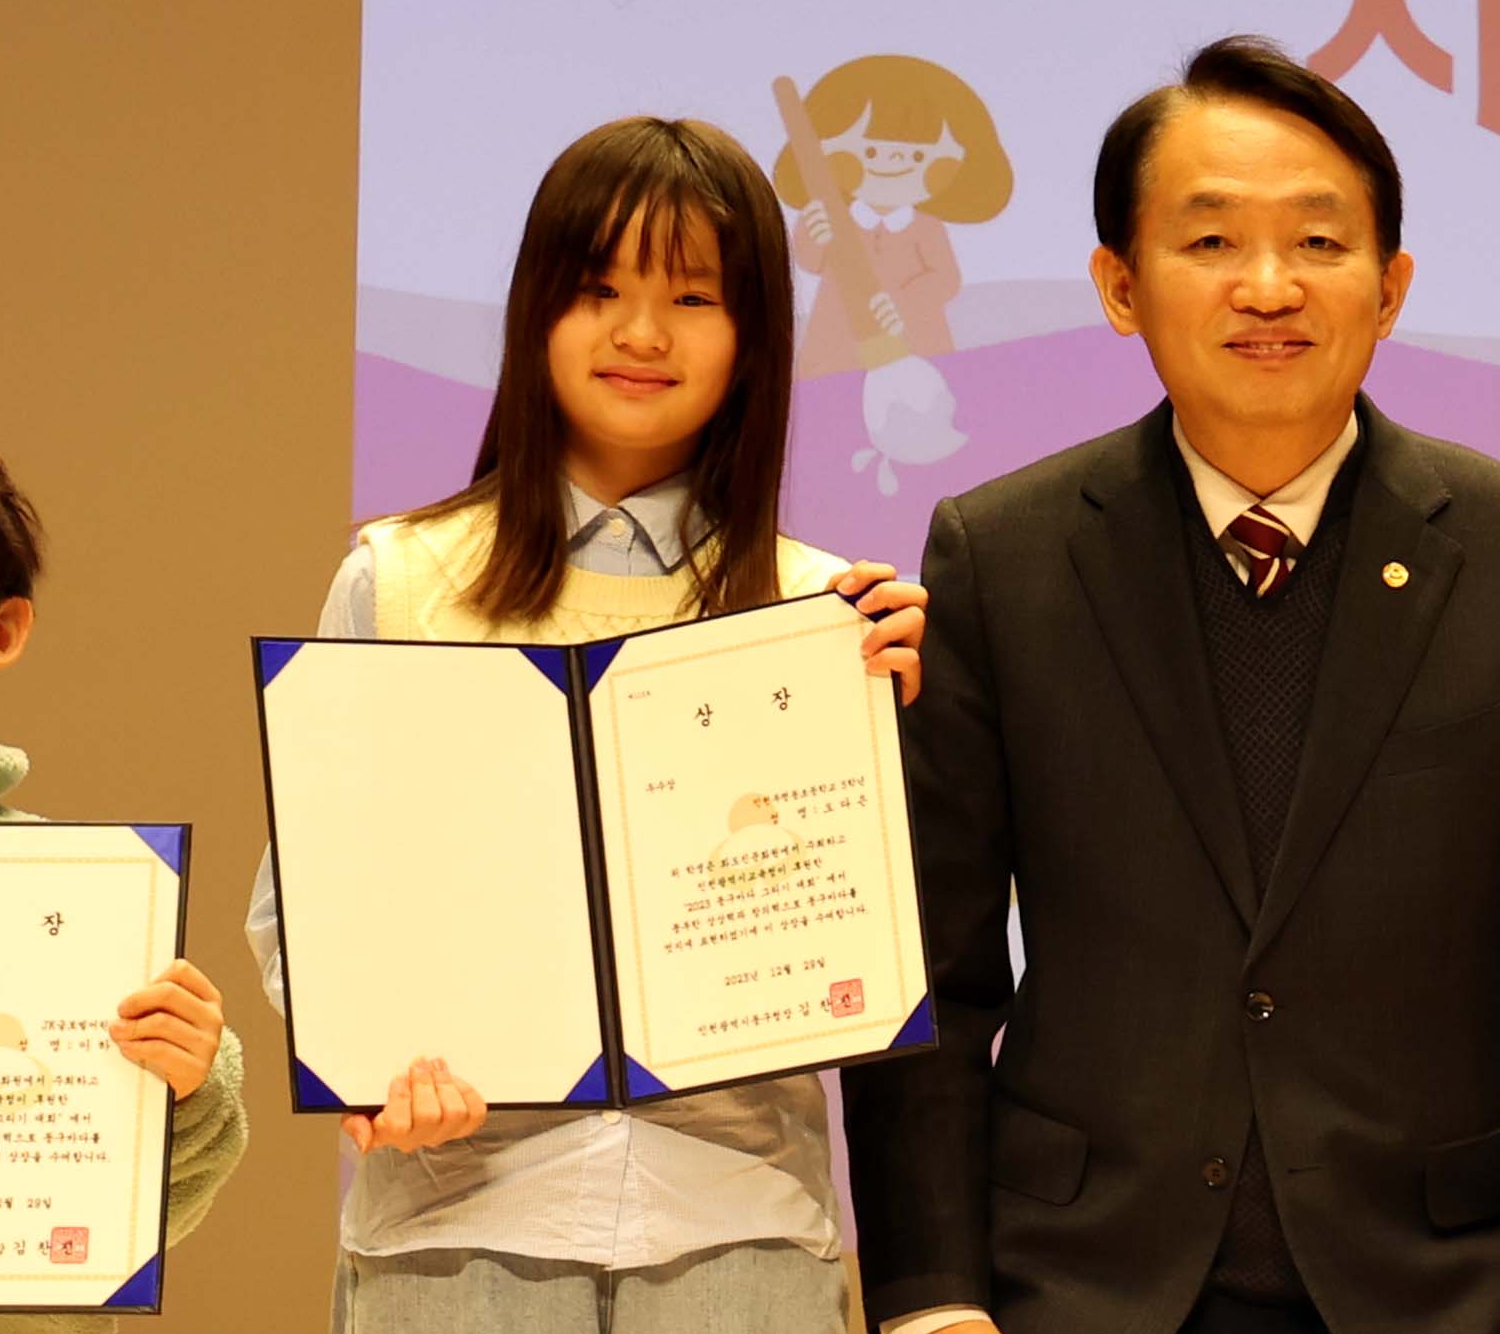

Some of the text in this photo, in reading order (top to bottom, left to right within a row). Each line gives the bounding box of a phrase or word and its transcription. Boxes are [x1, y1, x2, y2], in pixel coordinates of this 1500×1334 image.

[692, 685, 793, 728] 상 장
[39, 910, 66, 937] 장
[26, 1196, 52, 1210] 29일
